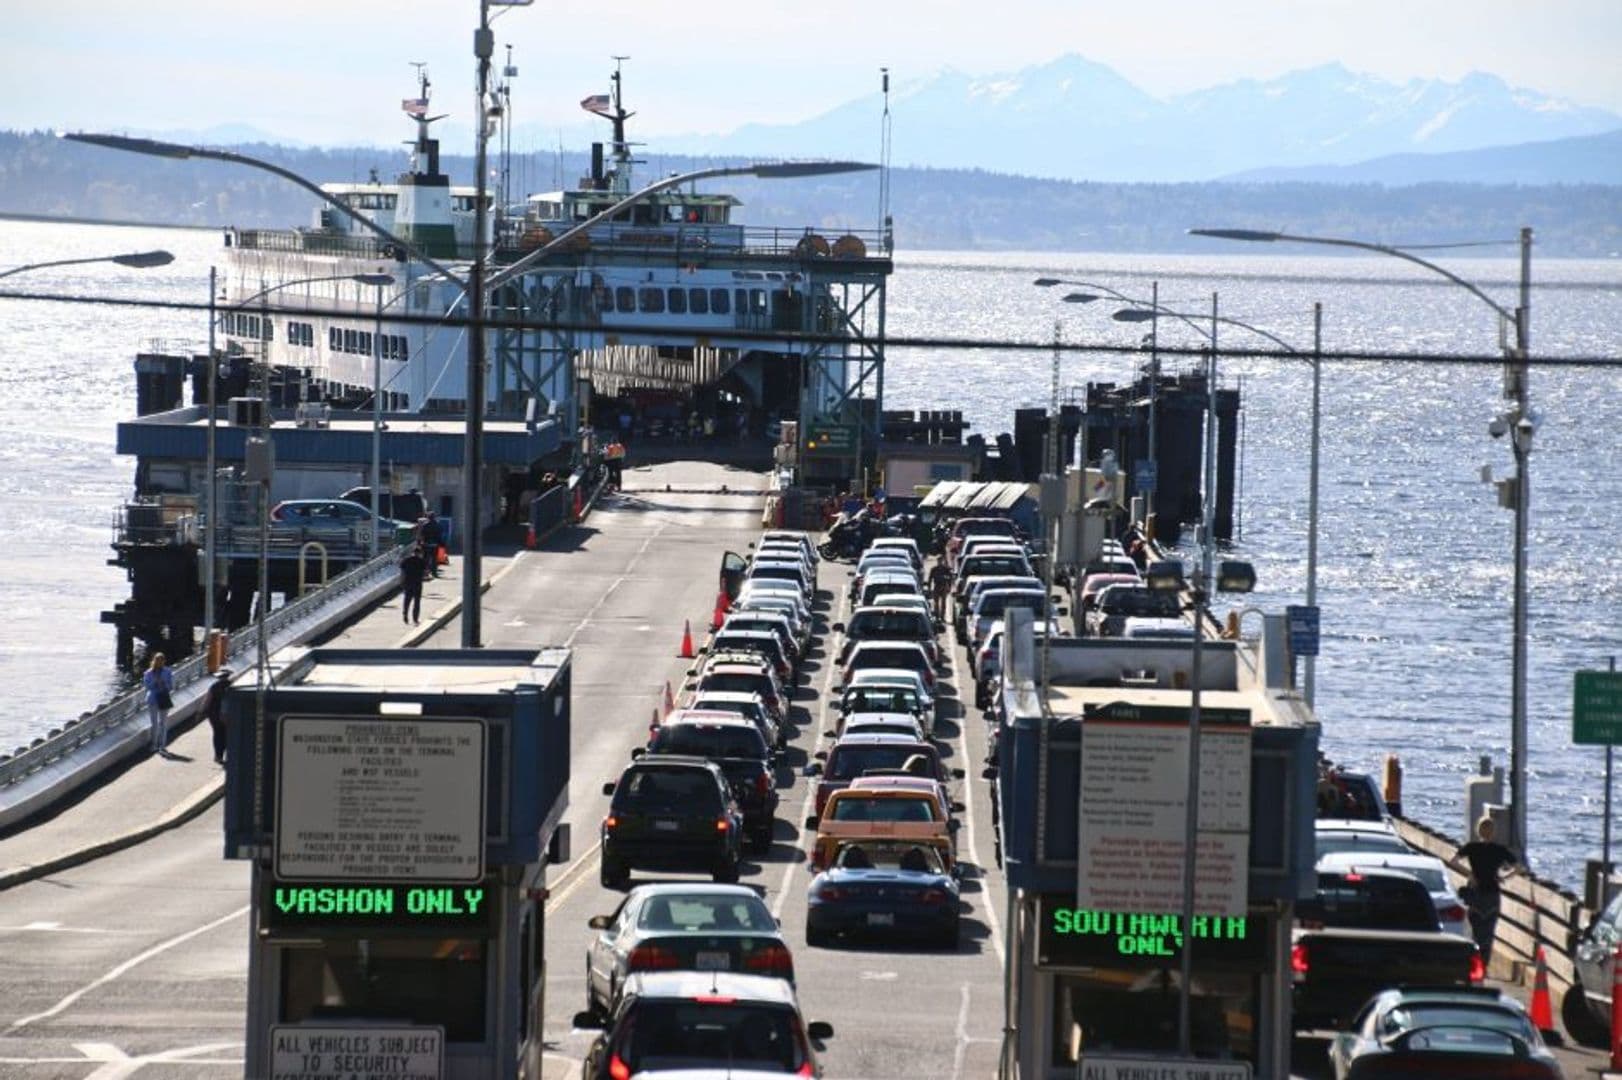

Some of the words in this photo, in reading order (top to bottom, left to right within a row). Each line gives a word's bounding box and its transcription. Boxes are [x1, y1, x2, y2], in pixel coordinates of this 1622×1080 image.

[275, 888, 394, 914] VASHON
[407, 889, 484, 914] ONLY
[277, 1036, 300, 1053] ALL
[308, 1036, 370, 1054] VEHICLES
[379, 1037, 436, 1055] SUBJECT
[303, 1055, 321, 1072] TO
[333, 1055, 410, 1073] SECURITY
